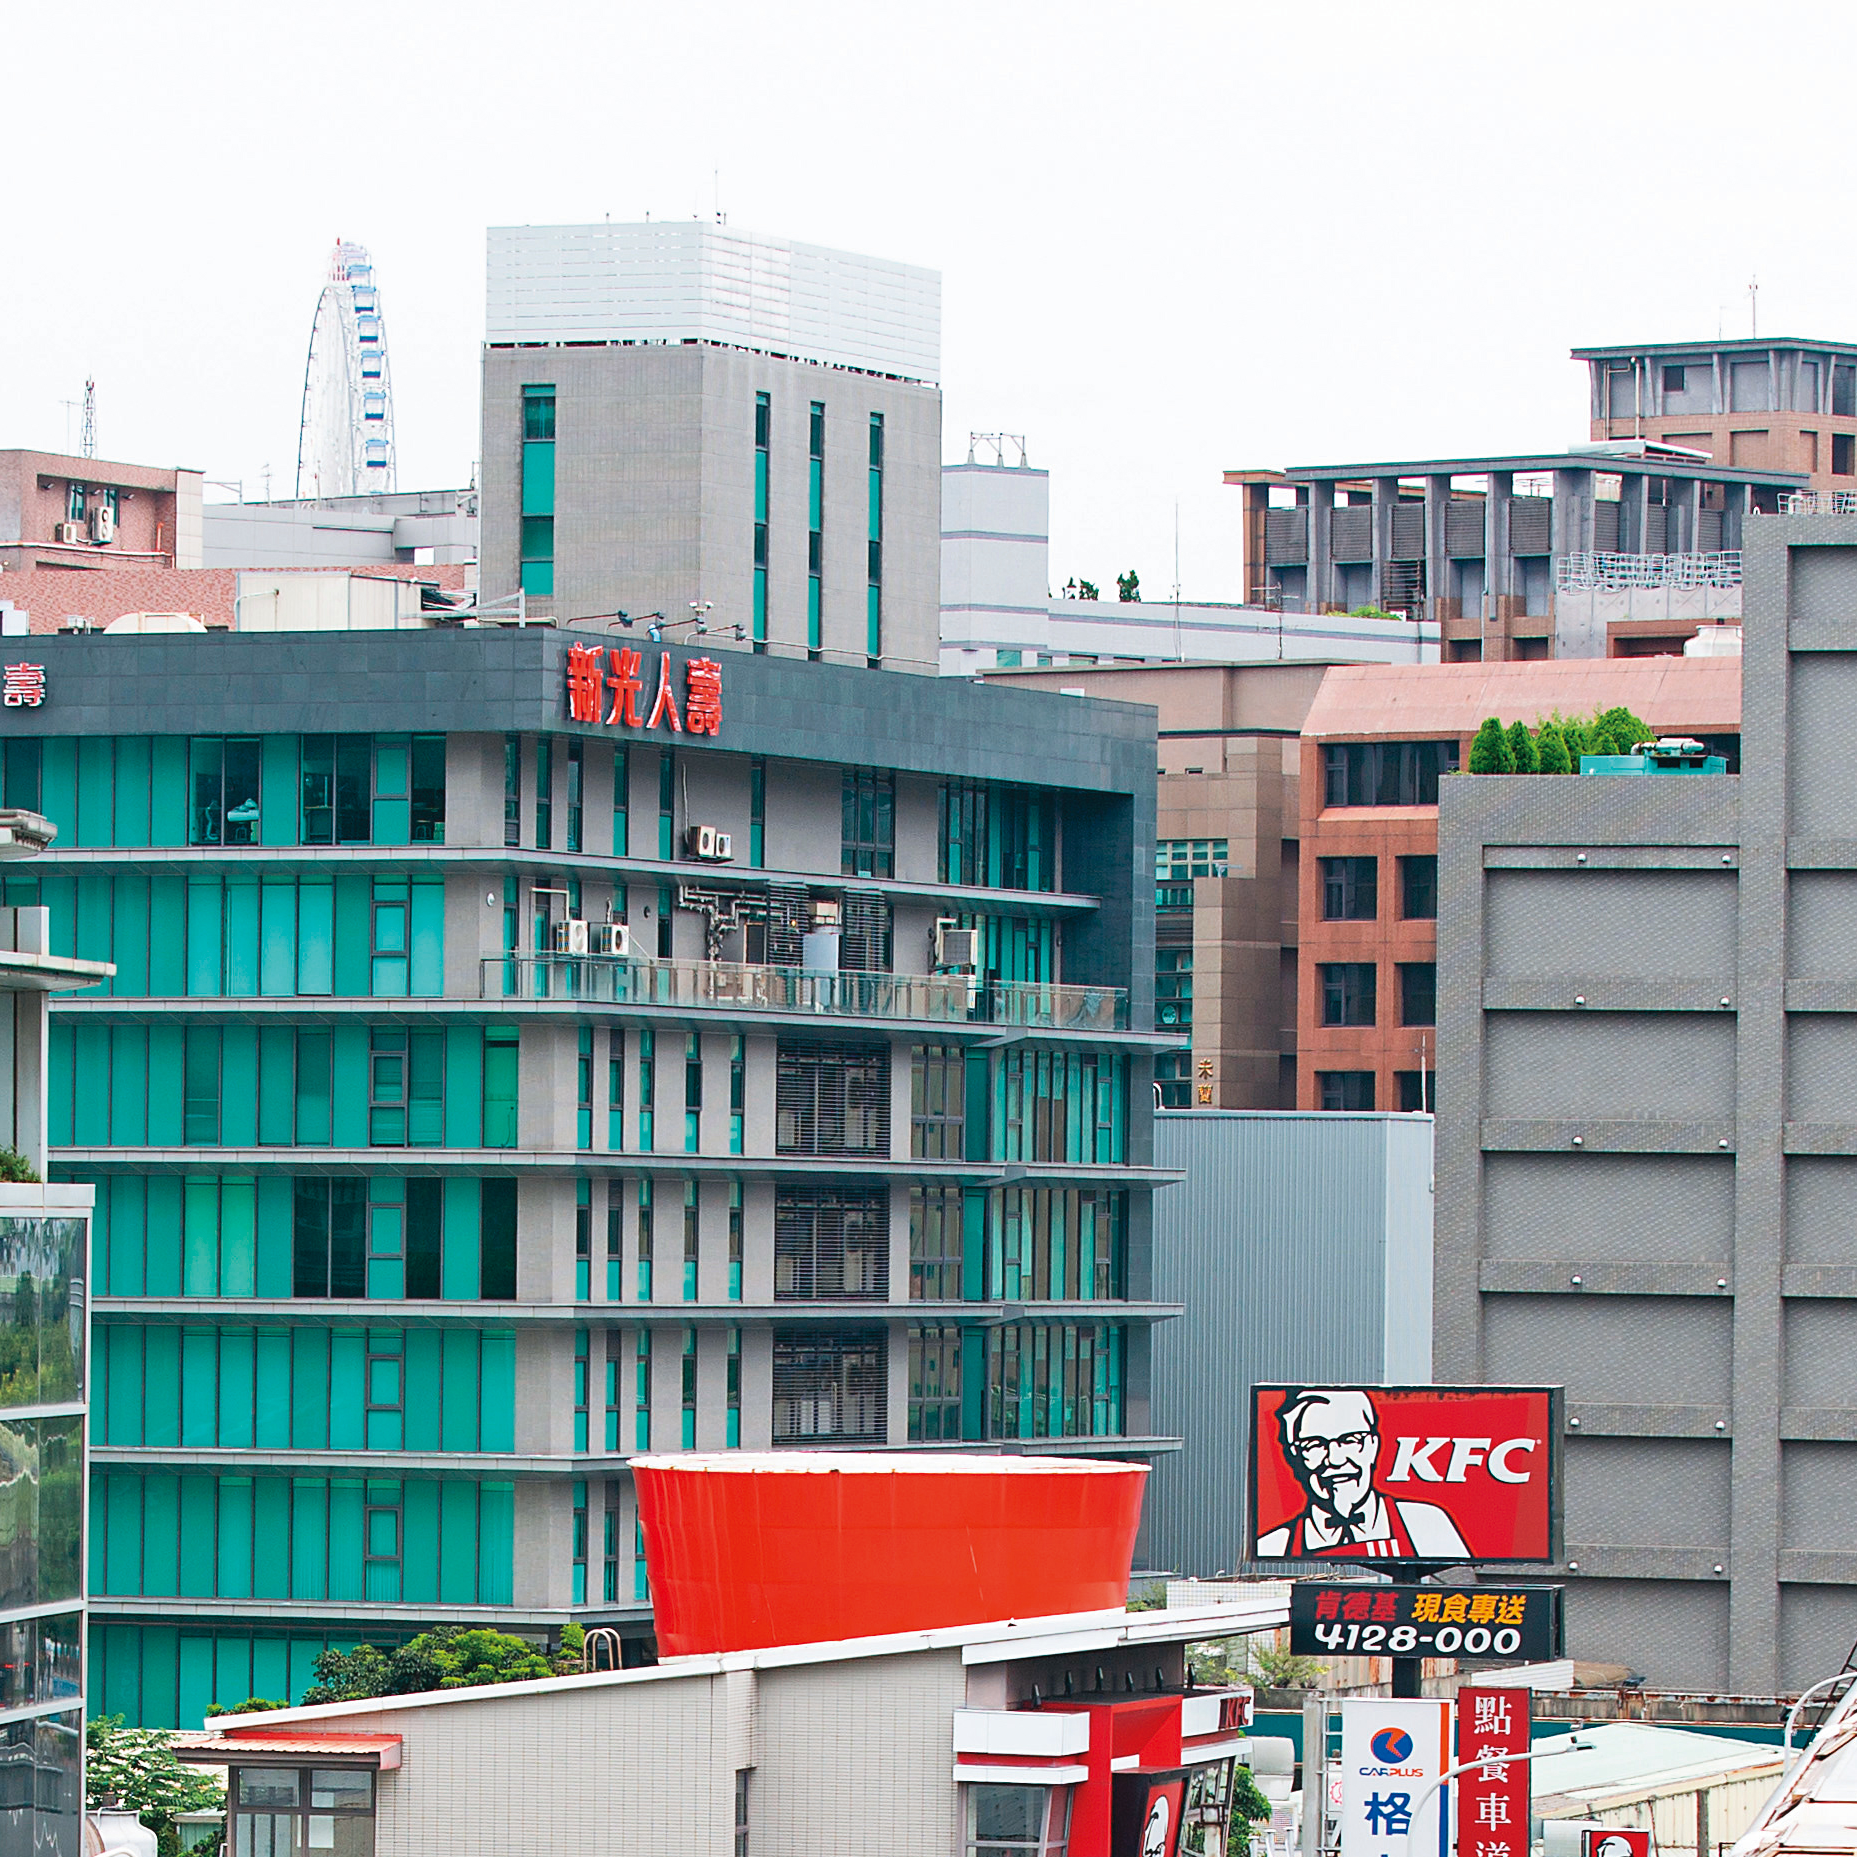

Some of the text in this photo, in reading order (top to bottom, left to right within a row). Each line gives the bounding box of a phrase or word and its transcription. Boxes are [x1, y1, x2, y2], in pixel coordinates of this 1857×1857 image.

[567, 641, 723, 737] 新光人壽
[1386, 1437, 1538, 1484] KFC
[1314, 1590, 1526, 1626] 肯德基 現食專送
[1314, 1622, 1522, 1655] 4128-000
[1359, 1766, 1424, 1778] CARPLUS
